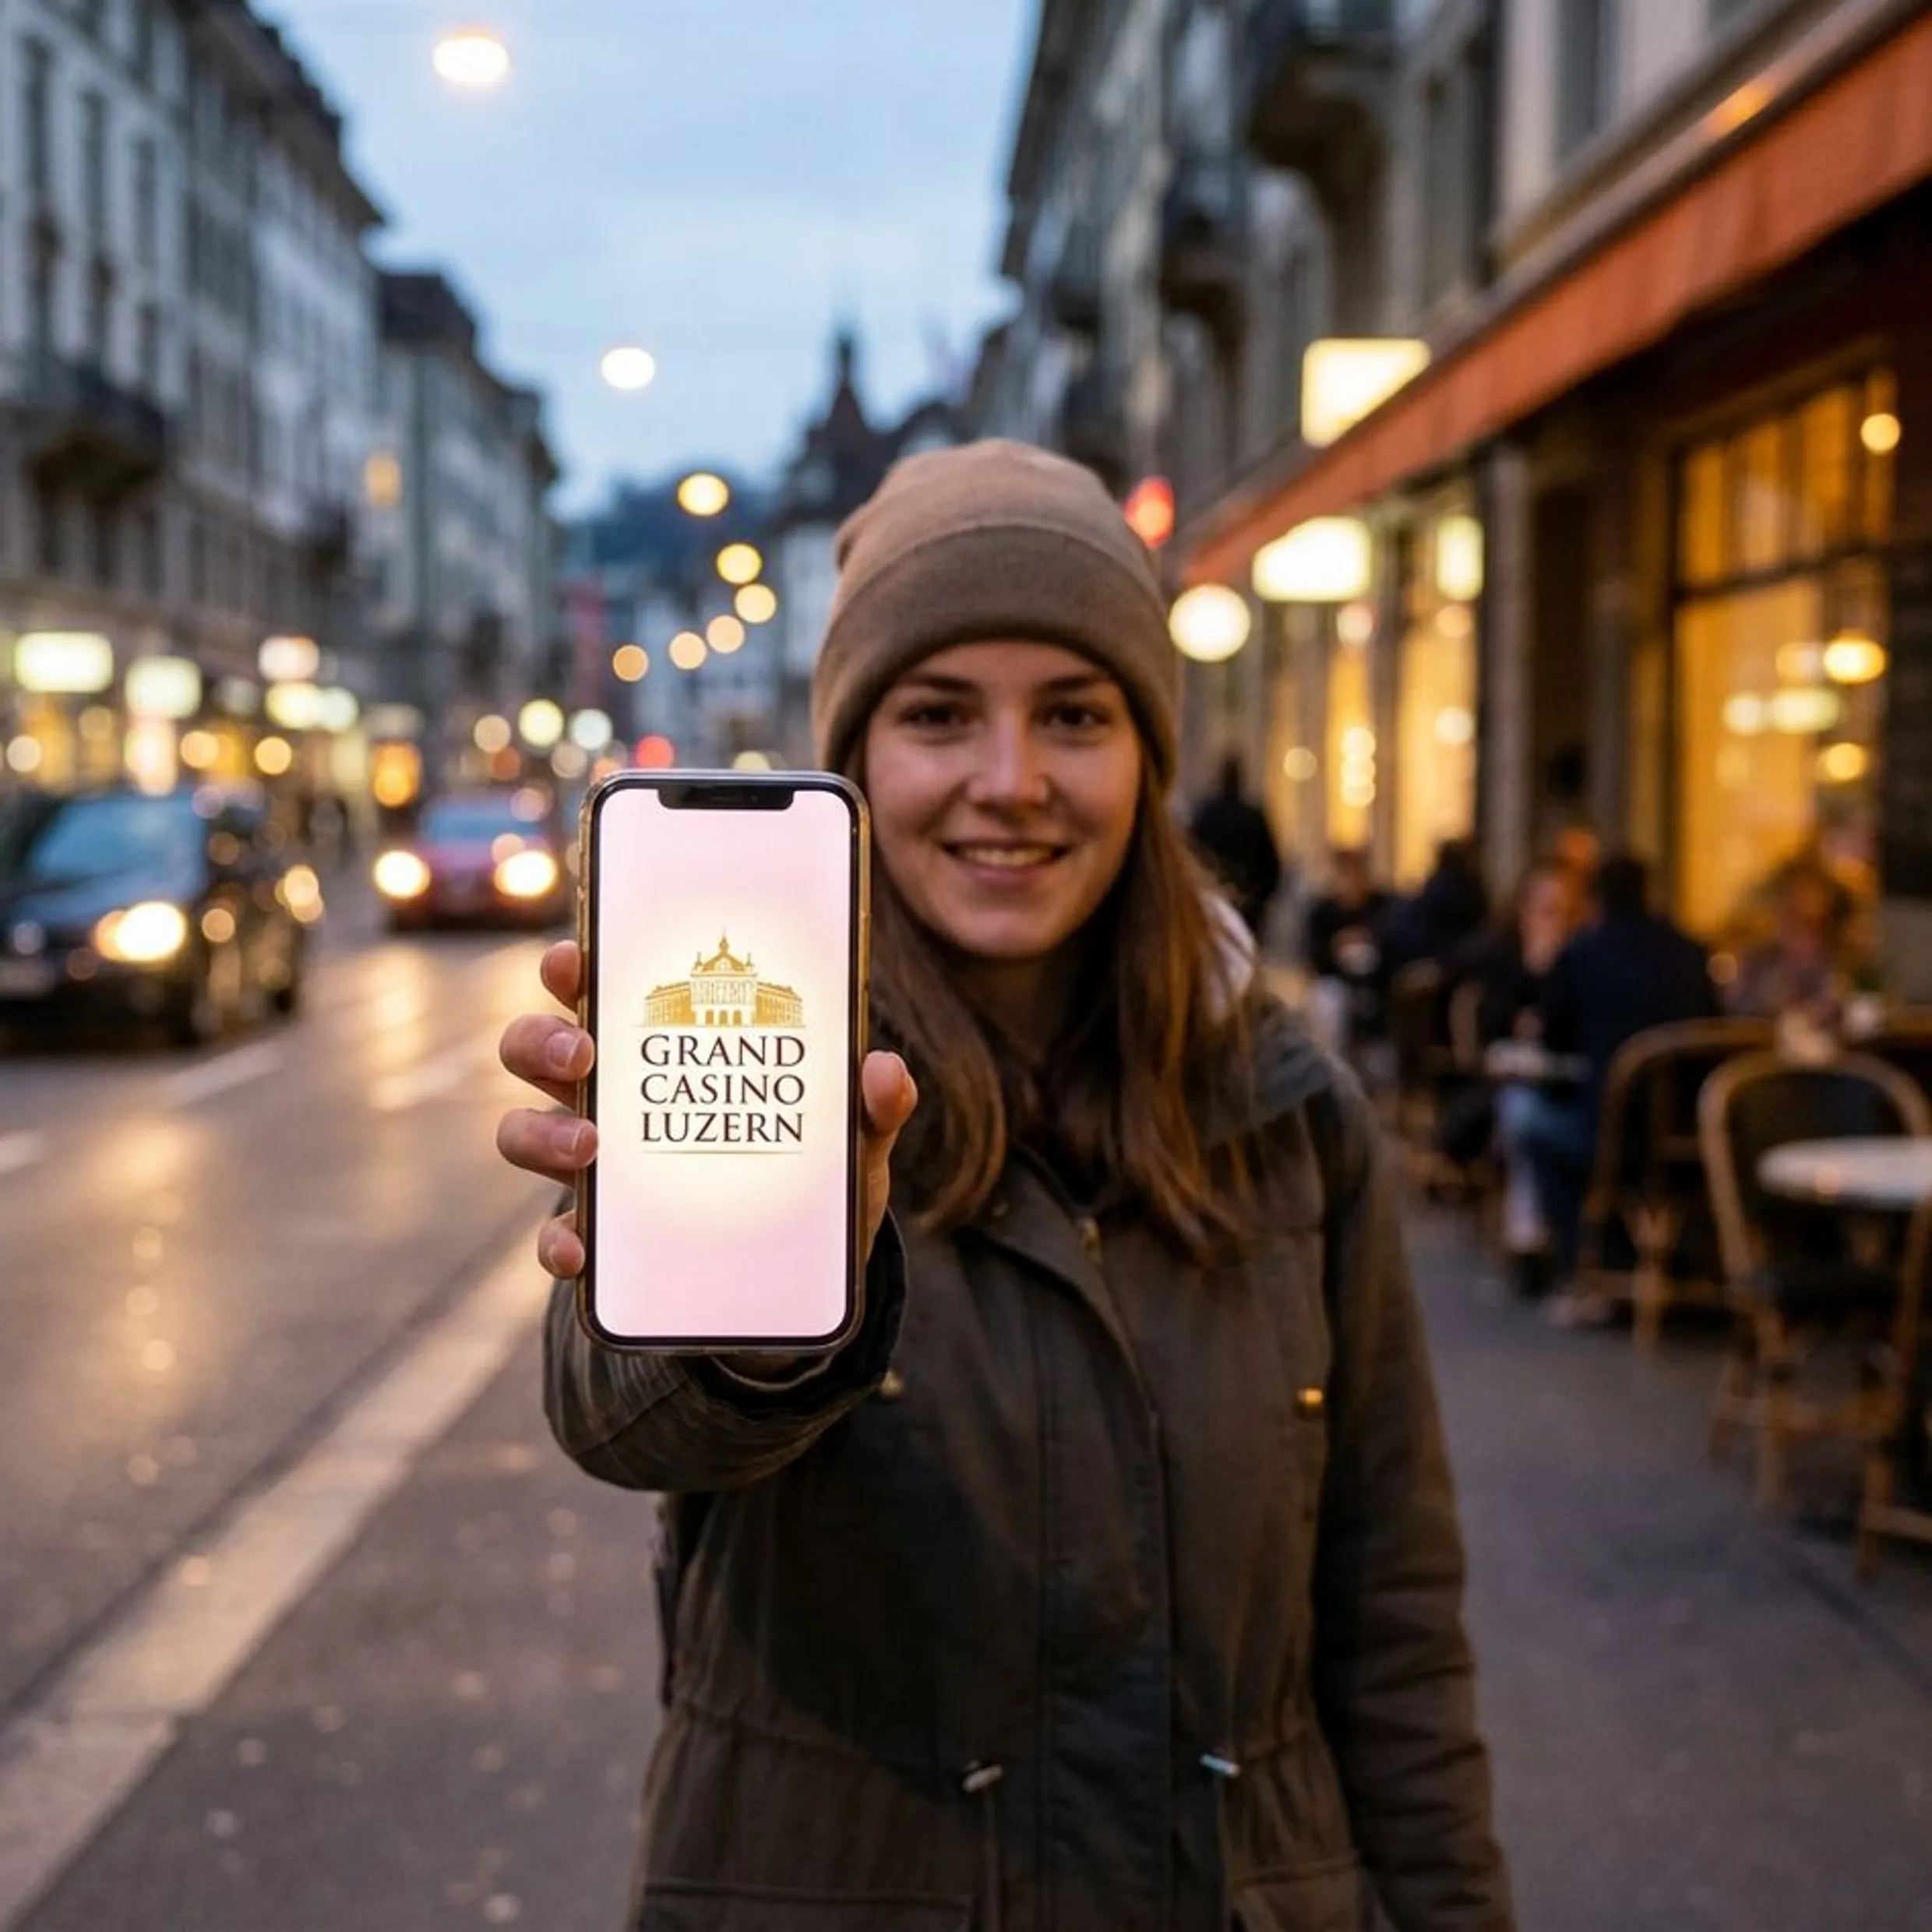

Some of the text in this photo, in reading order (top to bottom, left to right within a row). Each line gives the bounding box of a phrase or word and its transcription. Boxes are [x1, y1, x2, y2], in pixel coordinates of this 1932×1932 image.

[641, 1035, 805, 1066] GRAND
[641, 1074, 805, 1105] CASINO
[643, 1112, 802, 1142] LUZERN
